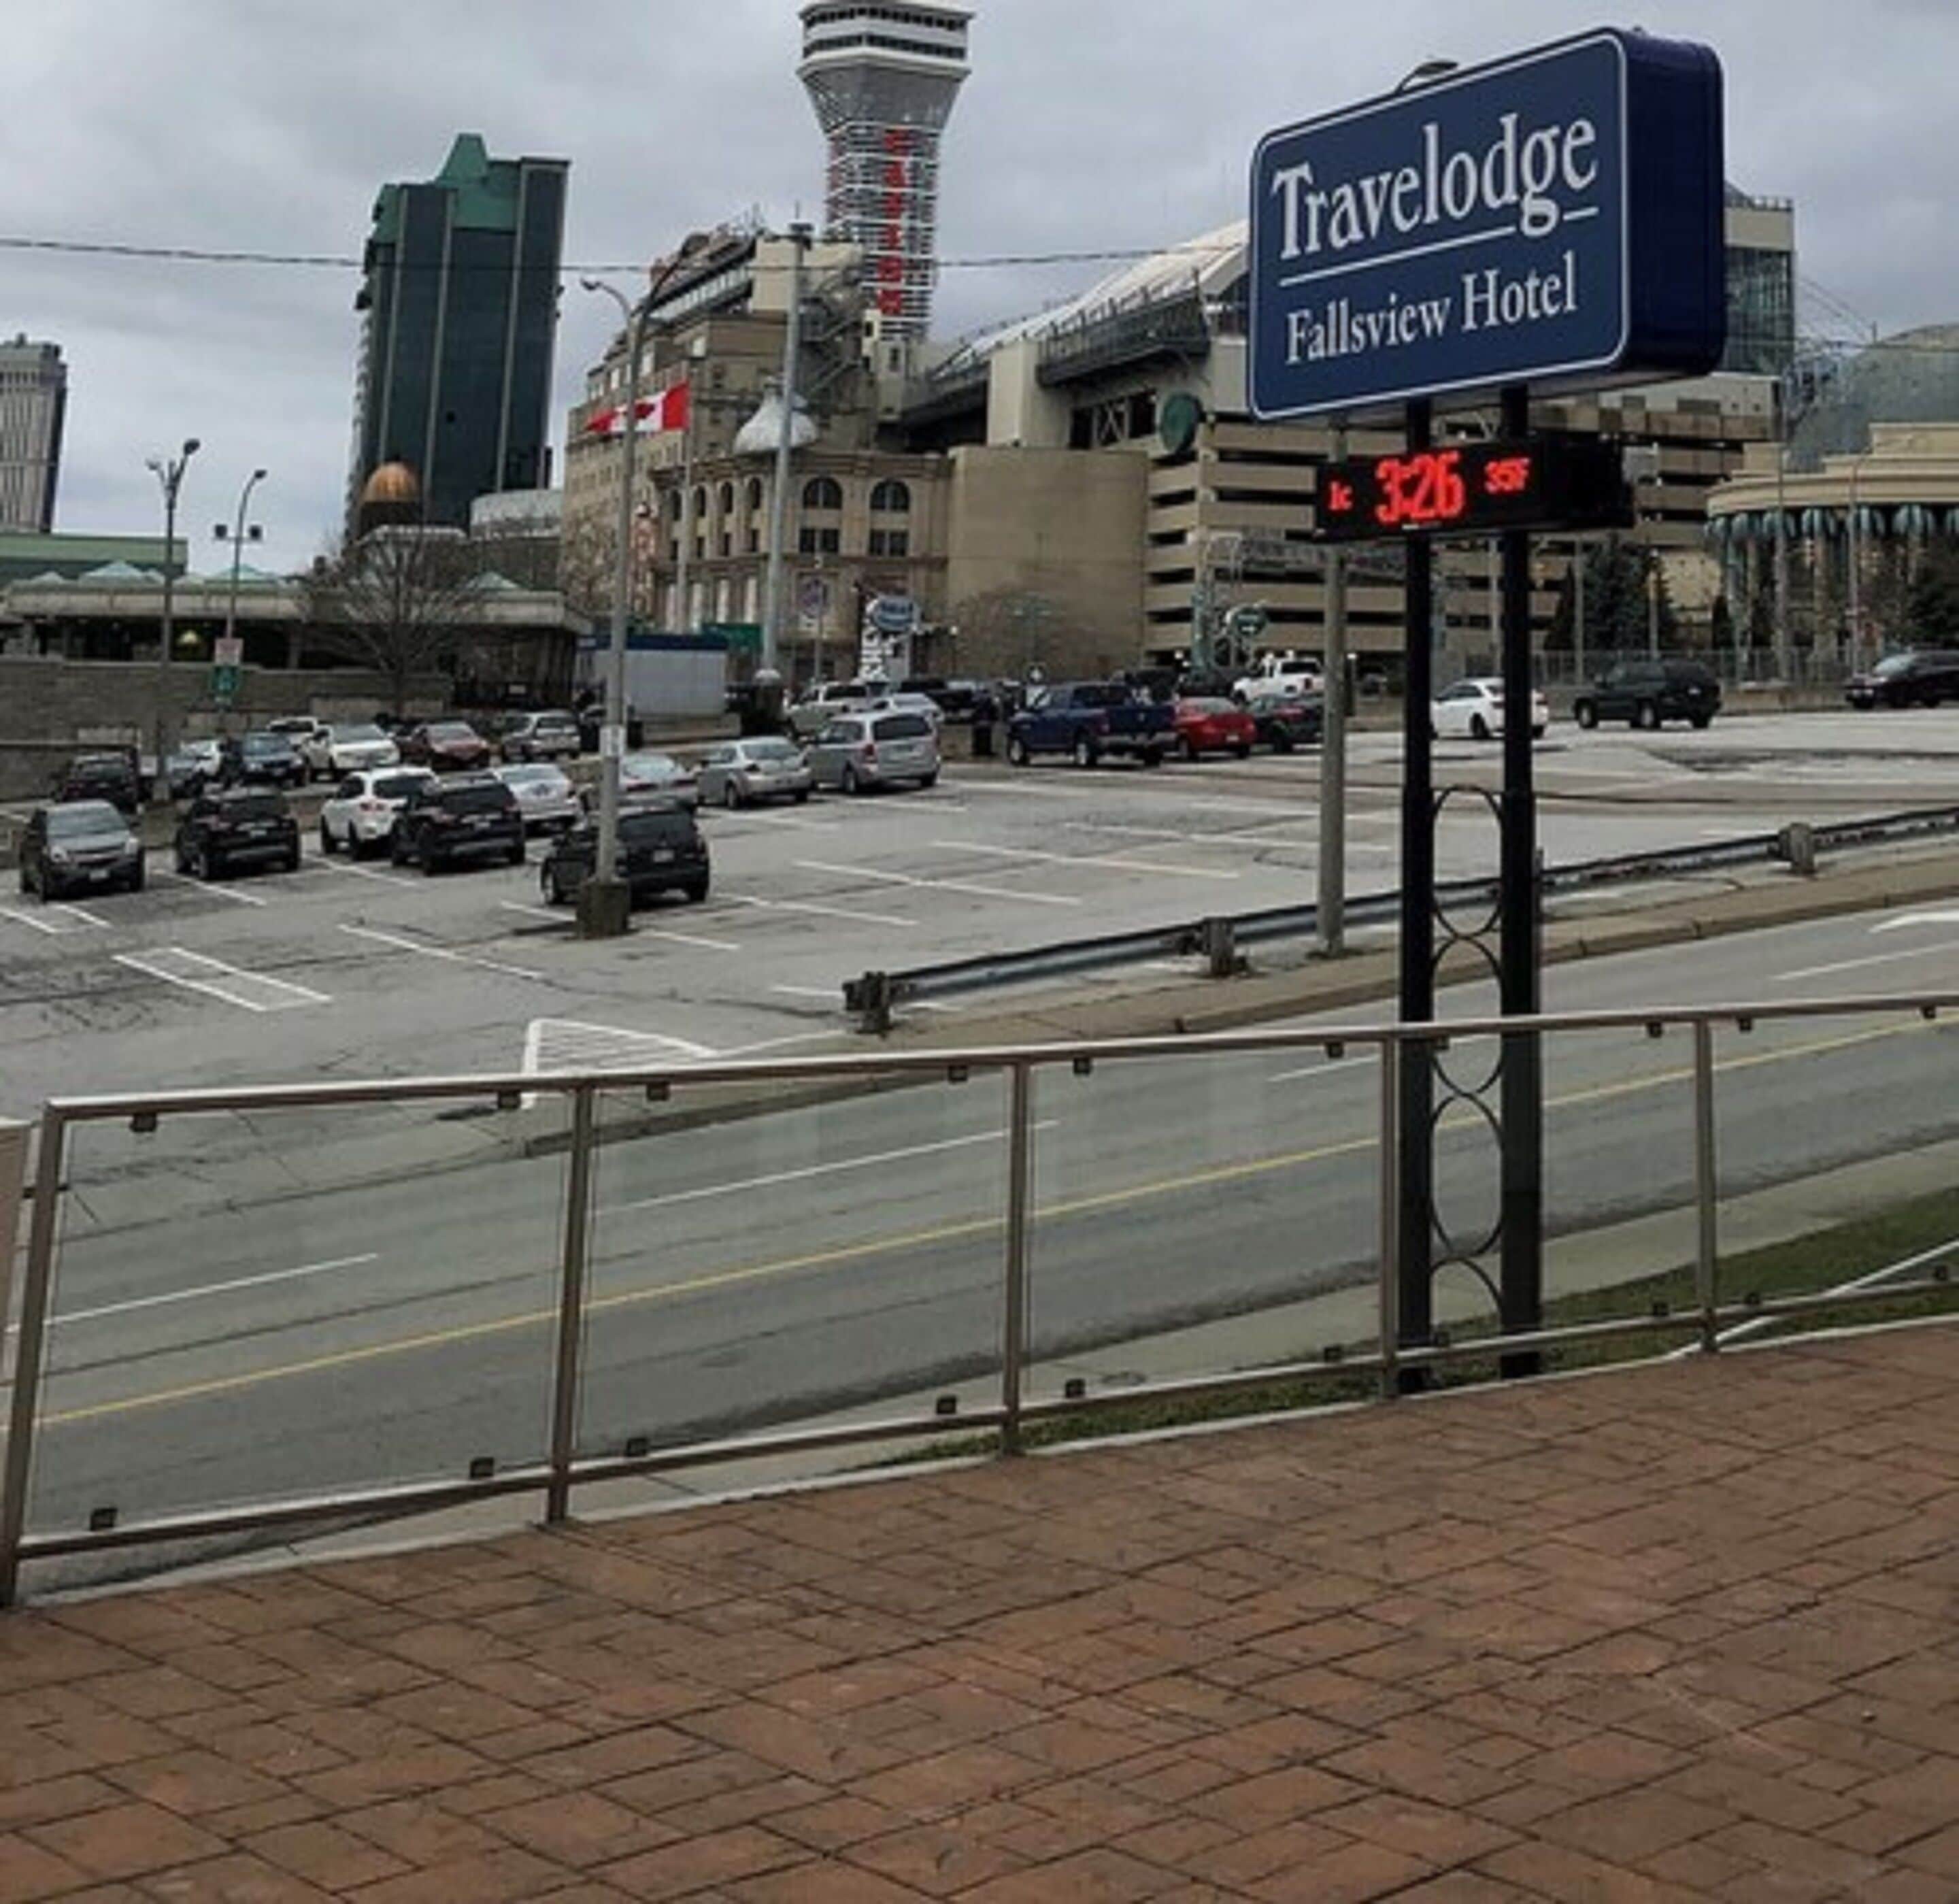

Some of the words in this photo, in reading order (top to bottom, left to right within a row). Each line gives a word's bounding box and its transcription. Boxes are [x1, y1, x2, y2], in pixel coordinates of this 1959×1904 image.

[1271, 112, 1598, 260] Travelodge
[1286, 292, 1451, 365] Fallsview
[1462, 250, 1577, 331] Hotel
